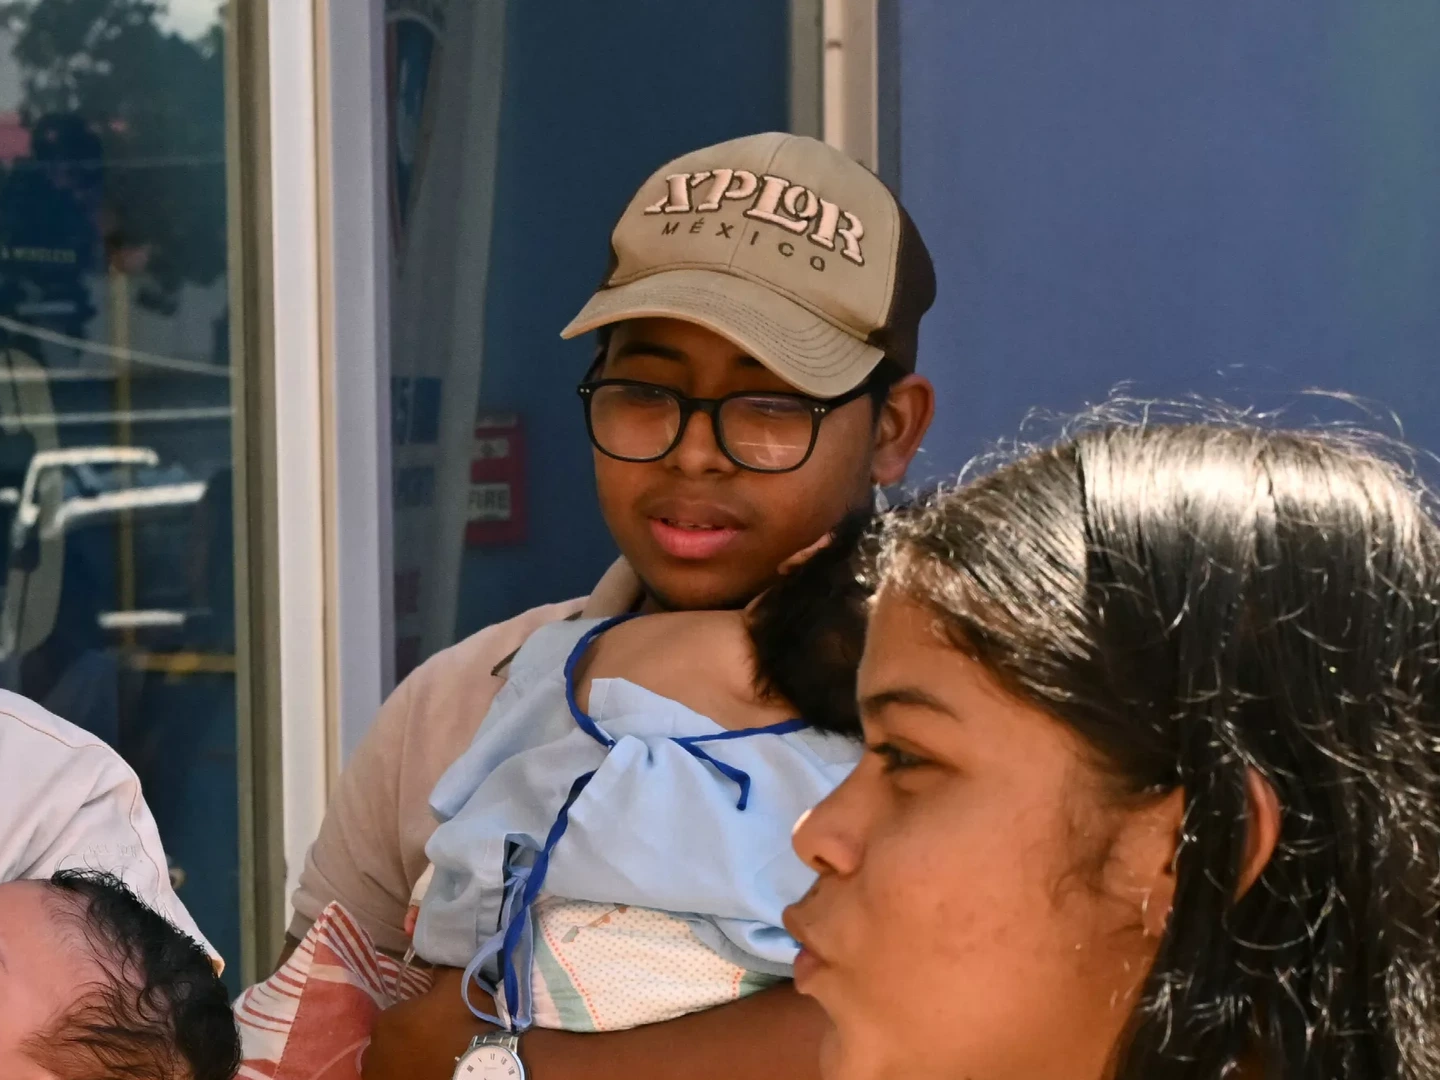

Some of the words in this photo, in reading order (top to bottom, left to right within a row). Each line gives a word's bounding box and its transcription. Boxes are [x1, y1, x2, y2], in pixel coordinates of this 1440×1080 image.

[643, 167, 865, 267] XPLOR
[661, 217, 826, 272] MÉXICO
[467, 489, 509, 511] FIRE
